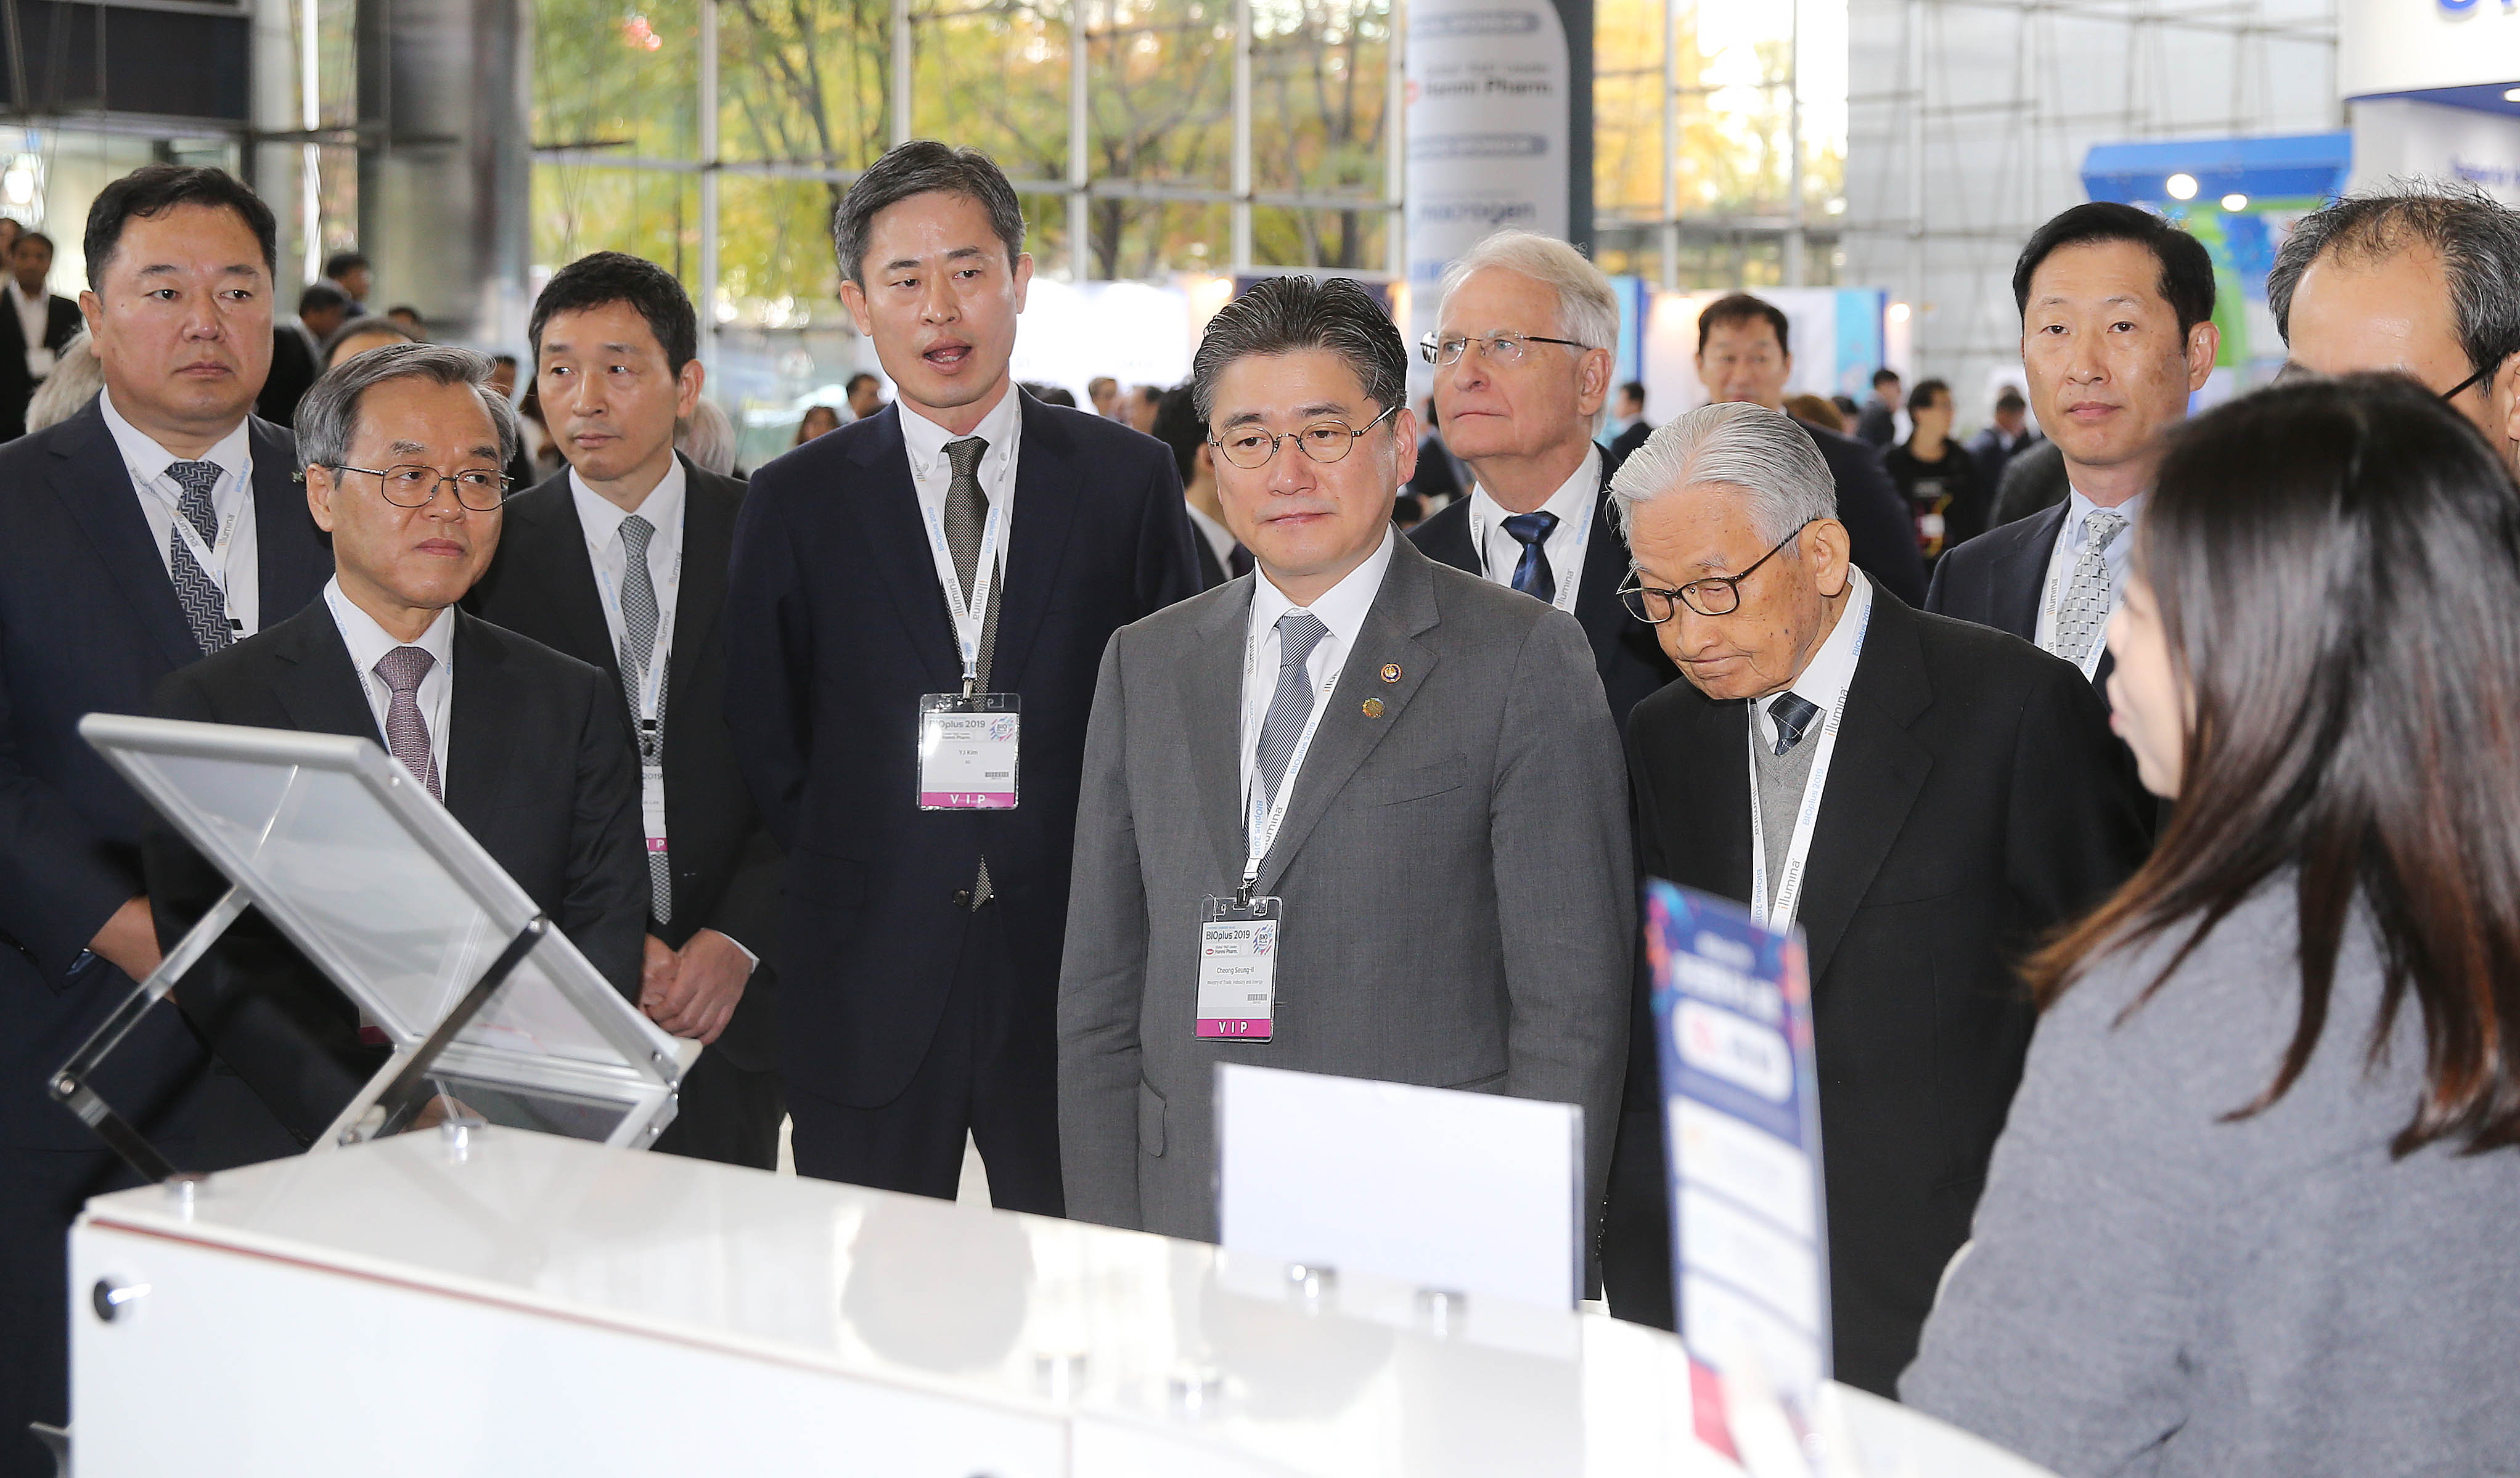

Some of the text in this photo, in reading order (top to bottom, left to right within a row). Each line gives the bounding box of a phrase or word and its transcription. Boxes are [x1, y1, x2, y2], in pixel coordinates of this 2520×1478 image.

[172, 512, 201, 547] illumina
[927, 507, 944, 552] BIOplus 2019
[986, 508, 999, 553] BIOplus 2019
[948, 577, 965, 617] illumina
[972, 580, 989, 621] illumina
[1556, 570, 1574, 608] illumina
[2046, 578, 2058, 616] illumina
[657, 611, 672, 645] illumina
[1862, 604, 1871, 624] 2019
[353, 656, 372, 696] illumina
[965, 720, 986, 728] 2019
[1824, 686, 1849, 737] illumina
[1290, 722, 1316, 775] BIOplus 2019
[1803, 767, 1824, 827] BIOplus 2019
[1254, 799, 1263, 855] BIOplus 2019
[1778, 857, 1801, 910] illumina
[1755, 904, 1763, 924] 2019
[1206, 929, 1251, 941] BIOplus 2019
